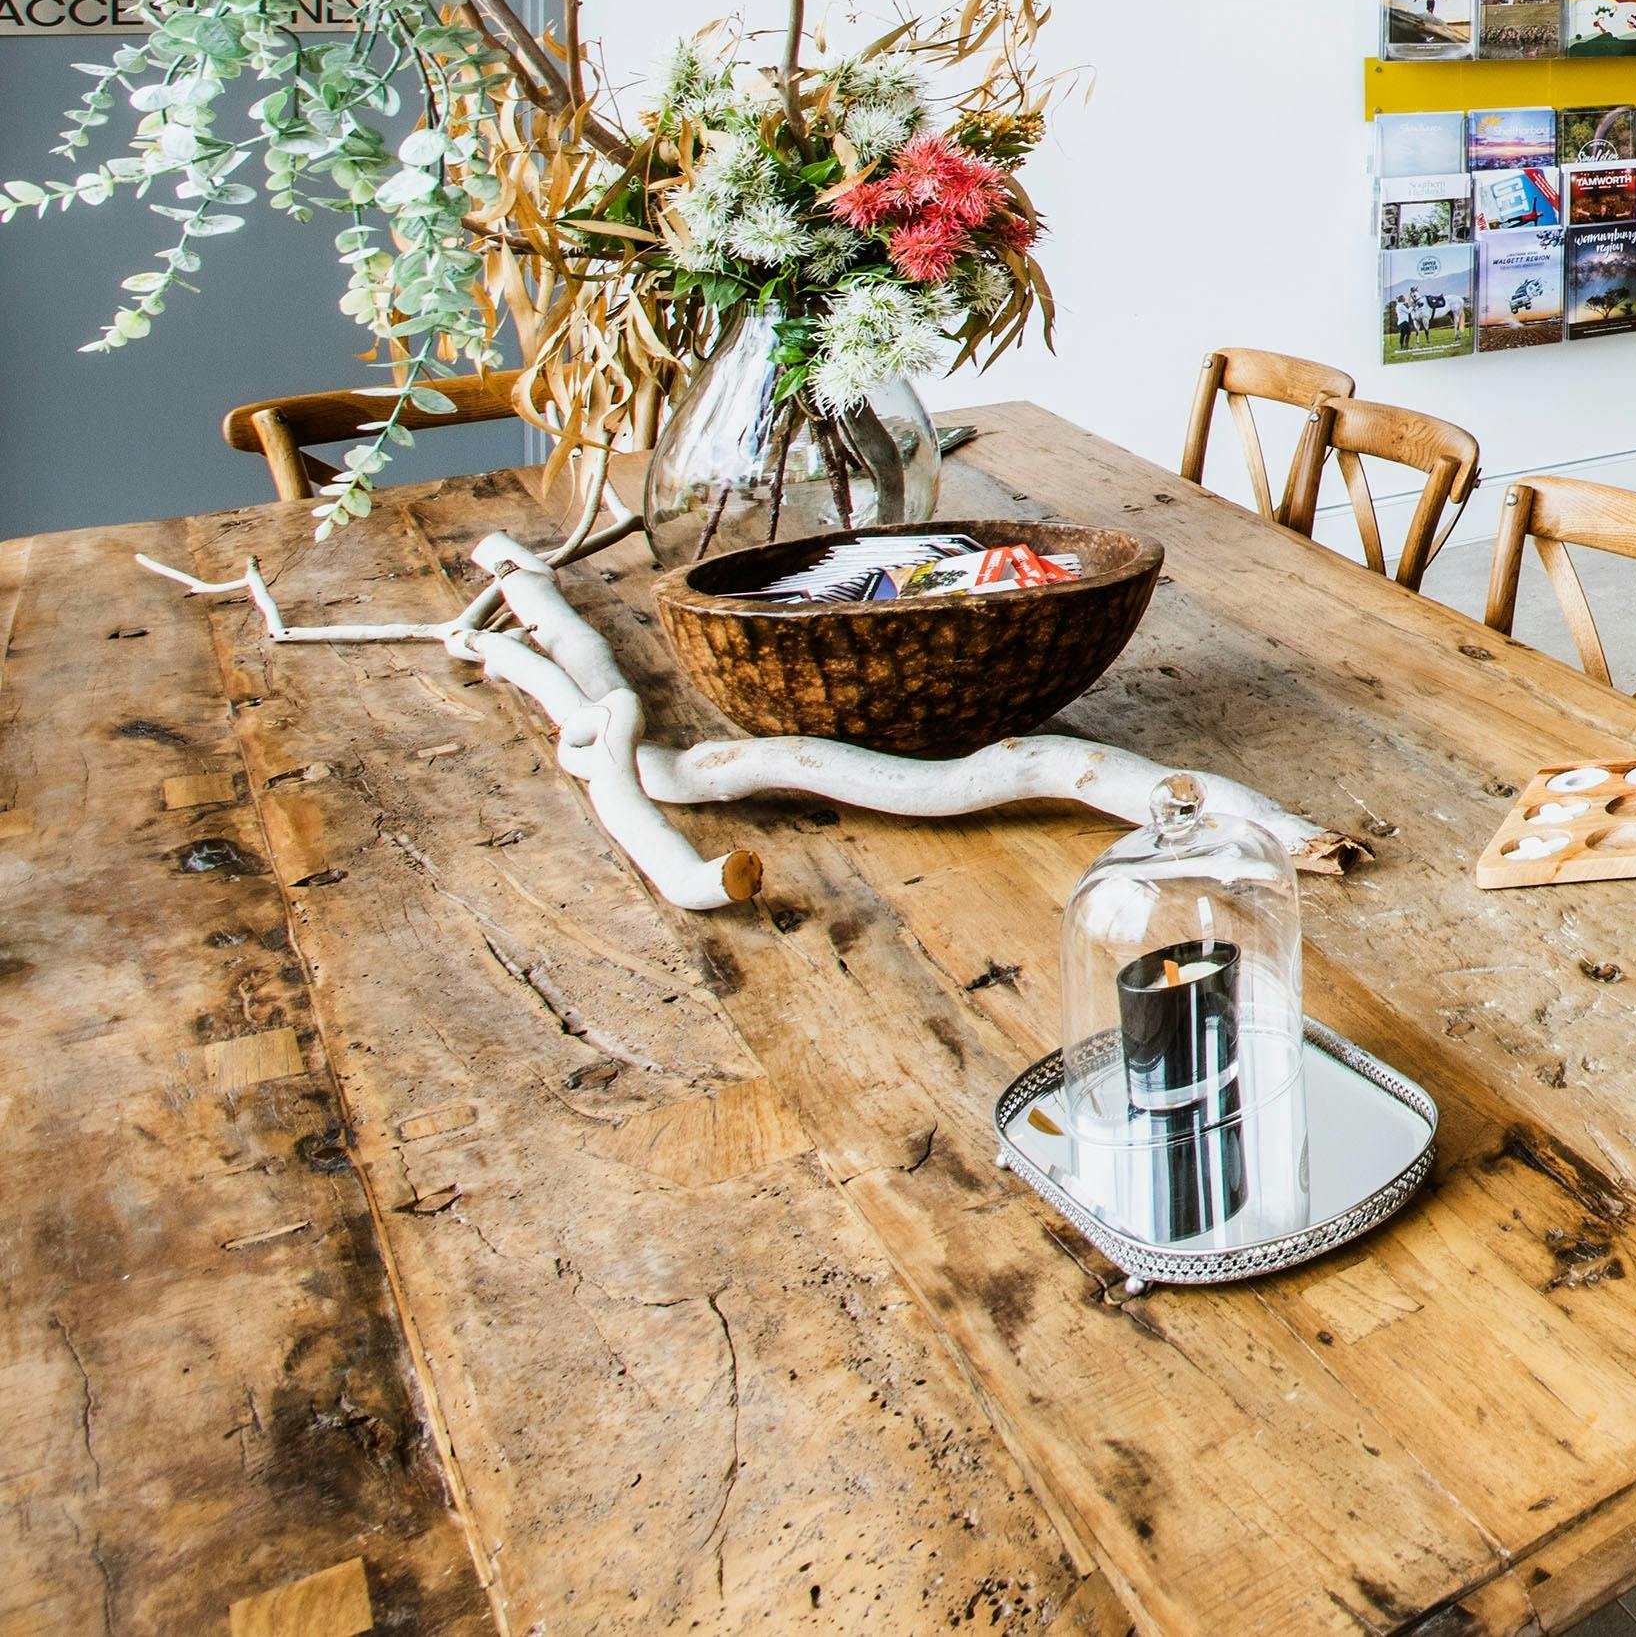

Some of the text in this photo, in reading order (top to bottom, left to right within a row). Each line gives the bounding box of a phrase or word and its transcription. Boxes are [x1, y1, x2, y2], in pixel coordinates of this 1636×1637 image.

[1576, 175, 1632, 187] TAMWORTH
[1596, 243, 1623, 258] region
[1492, 254, 1550, 265] WALGETT REGION
